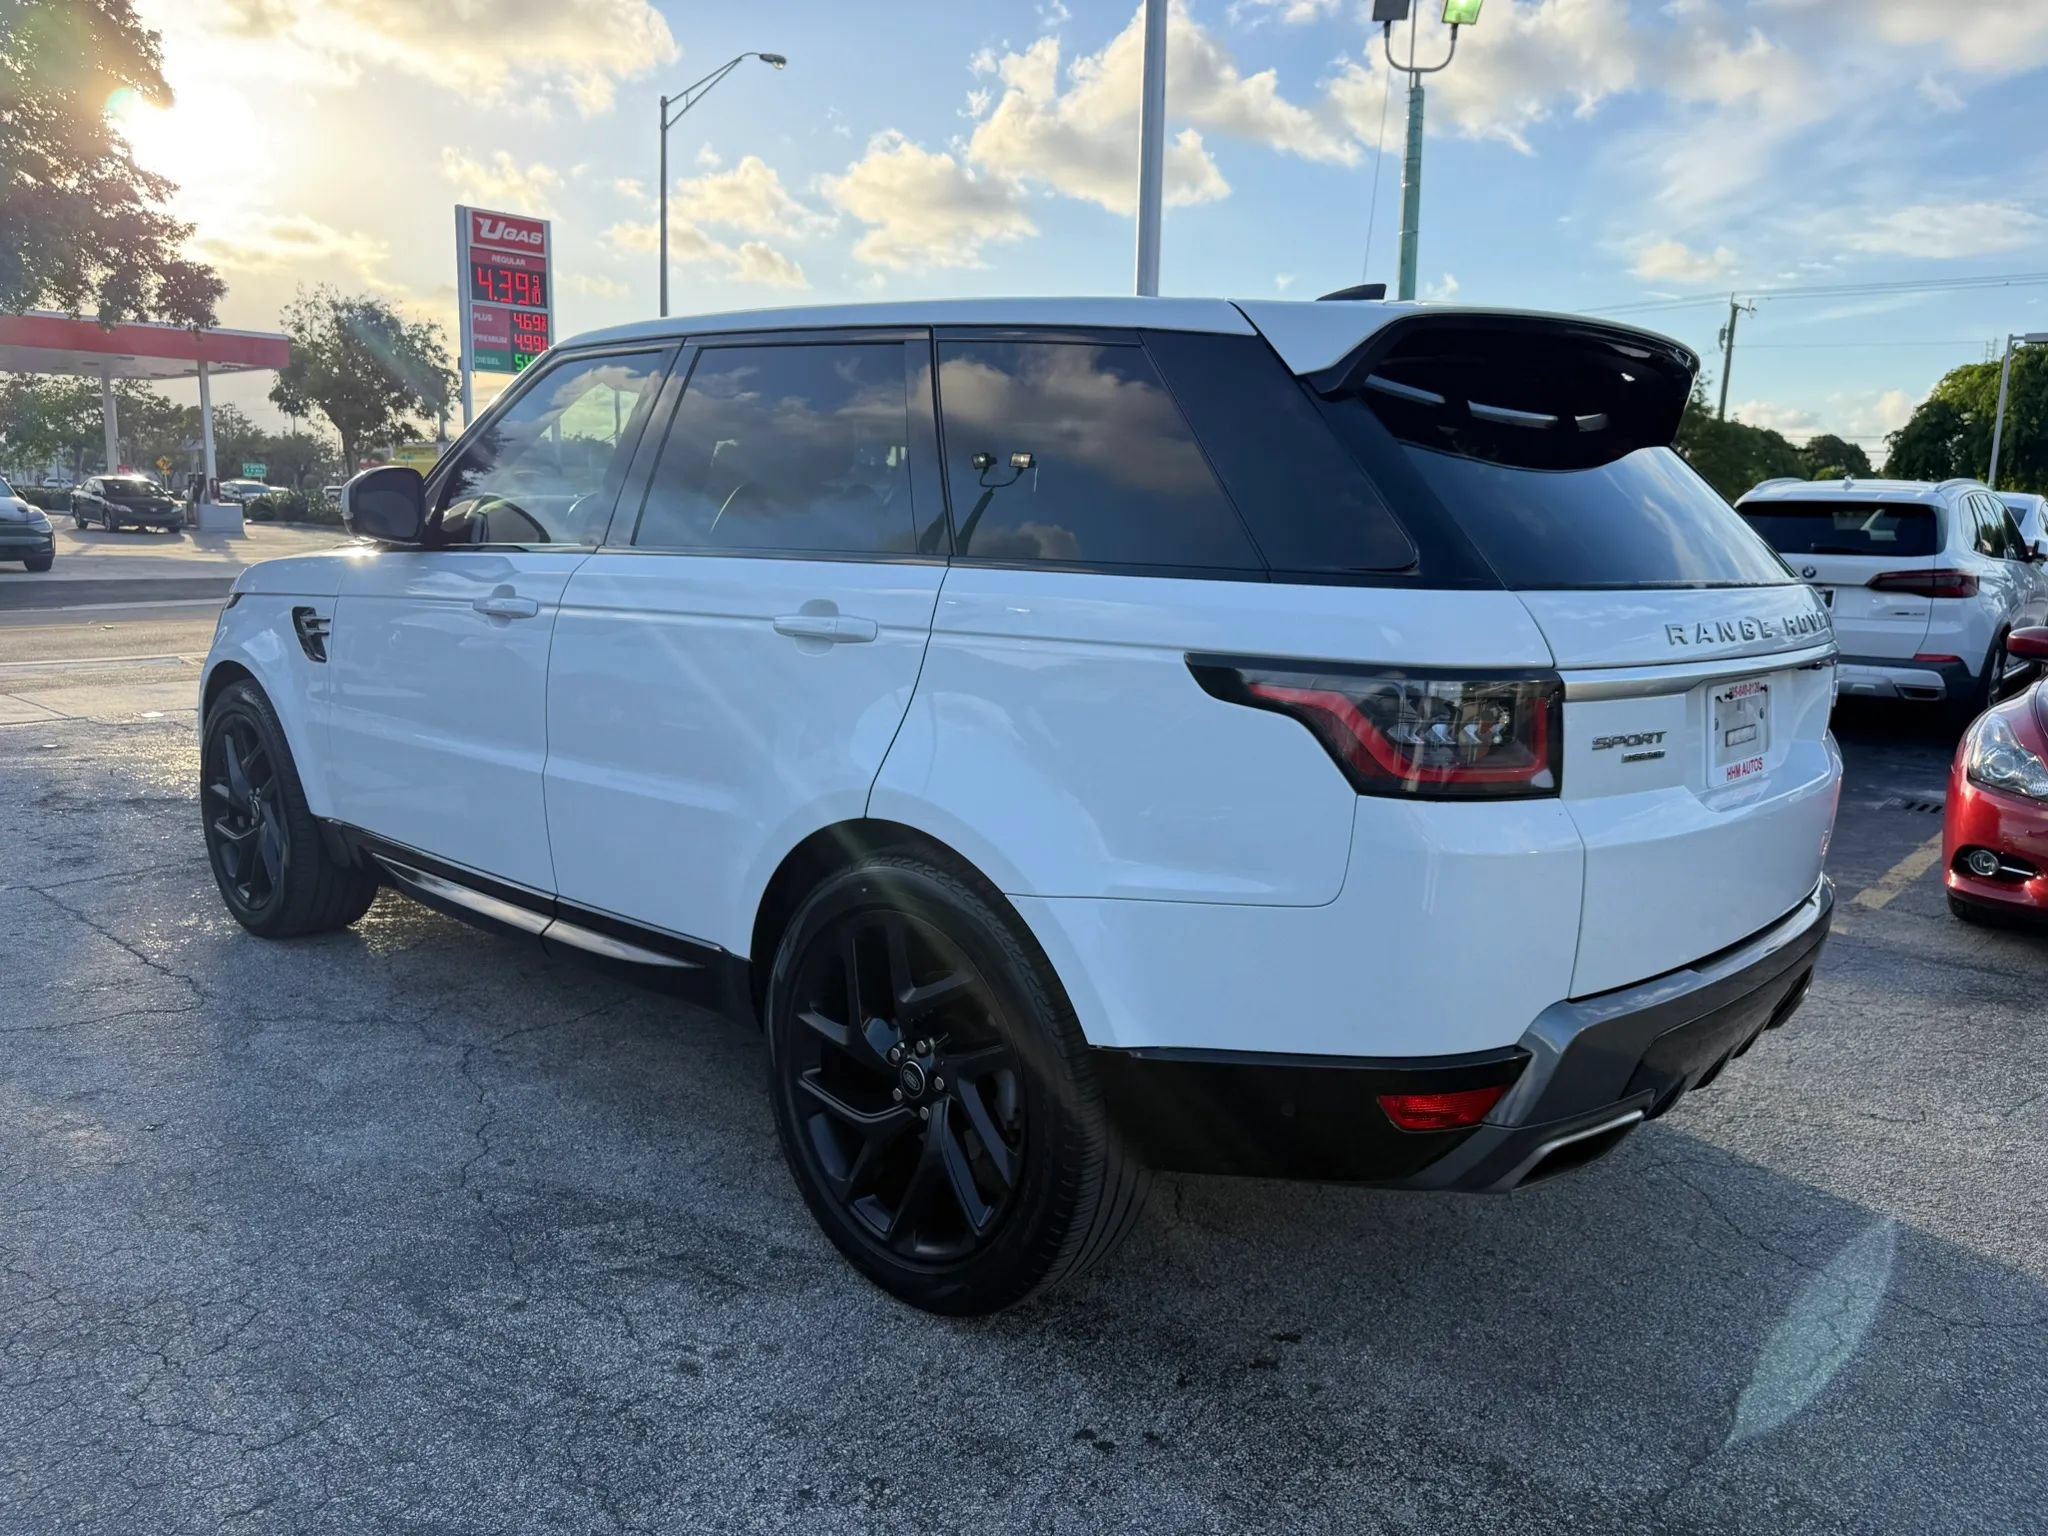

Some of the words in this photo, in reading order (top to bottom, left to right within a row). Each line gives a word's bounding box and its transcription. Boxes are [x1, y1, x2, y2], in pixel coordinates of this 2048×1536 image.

[491, 254, 526, 266] REGULAR
[474, 312, 493, 321] PLUS
[475, 355, 500, 365] DIESEL
[1664, 617, 1773, 646] RANGE
[1591, 731, 1668, 751] SPORT
[1726, 763, 1742, 781] HHM
[1742, 757, 1763, 776] AUTOS
